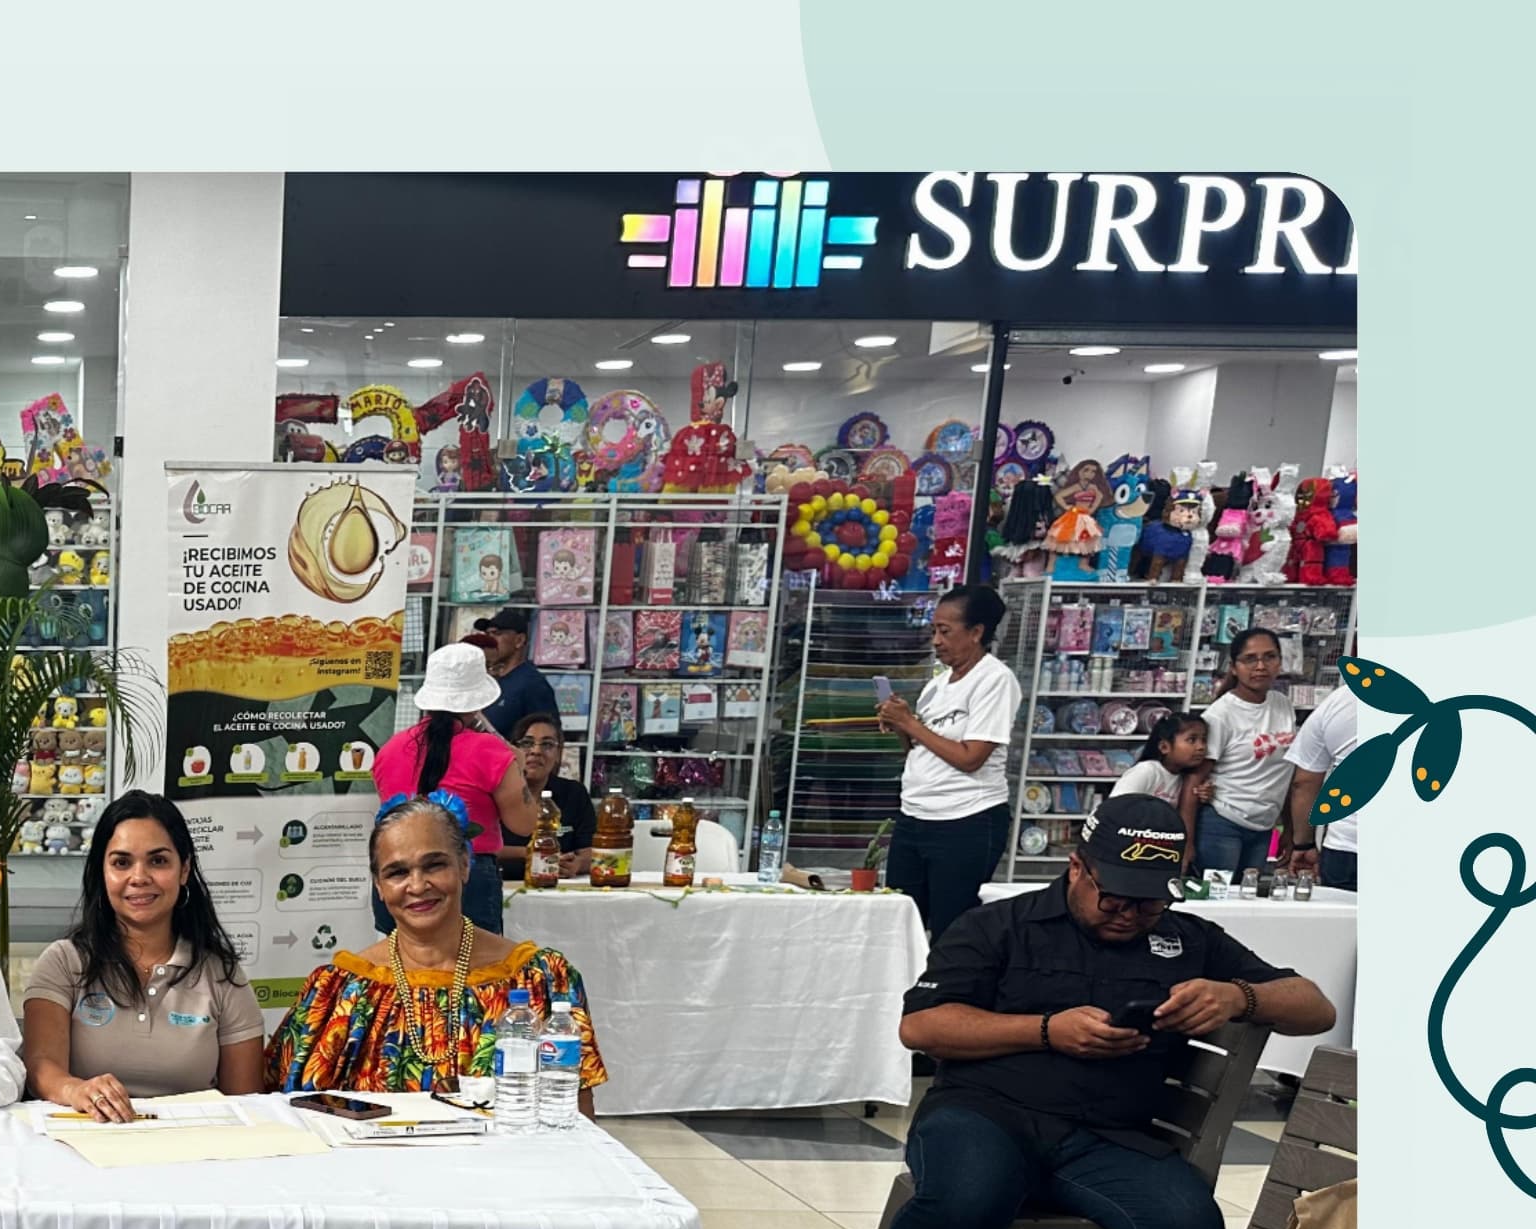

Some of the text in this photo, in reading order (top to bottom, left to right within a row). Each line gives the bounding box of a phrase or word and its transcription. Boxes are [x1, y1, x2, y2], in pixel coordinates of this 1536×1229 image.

[350, 391, 403, 411] MARIO
[182, 547, 277, 564] ¡RECIBIMOS
[183, 564, 262, 578] TU ACEITE
[184, 580, 270, 594] DE COCINA
[184, 597, 241, 611] USADO!
[268, 710, 326, 719] RECOLECTAR
[225, 722, 254, 731] ACEITE
[258, 722, 270, 730] DE
[272, 721, 307, 730] COCINA
[310, 720, 346, 729] USADO?
